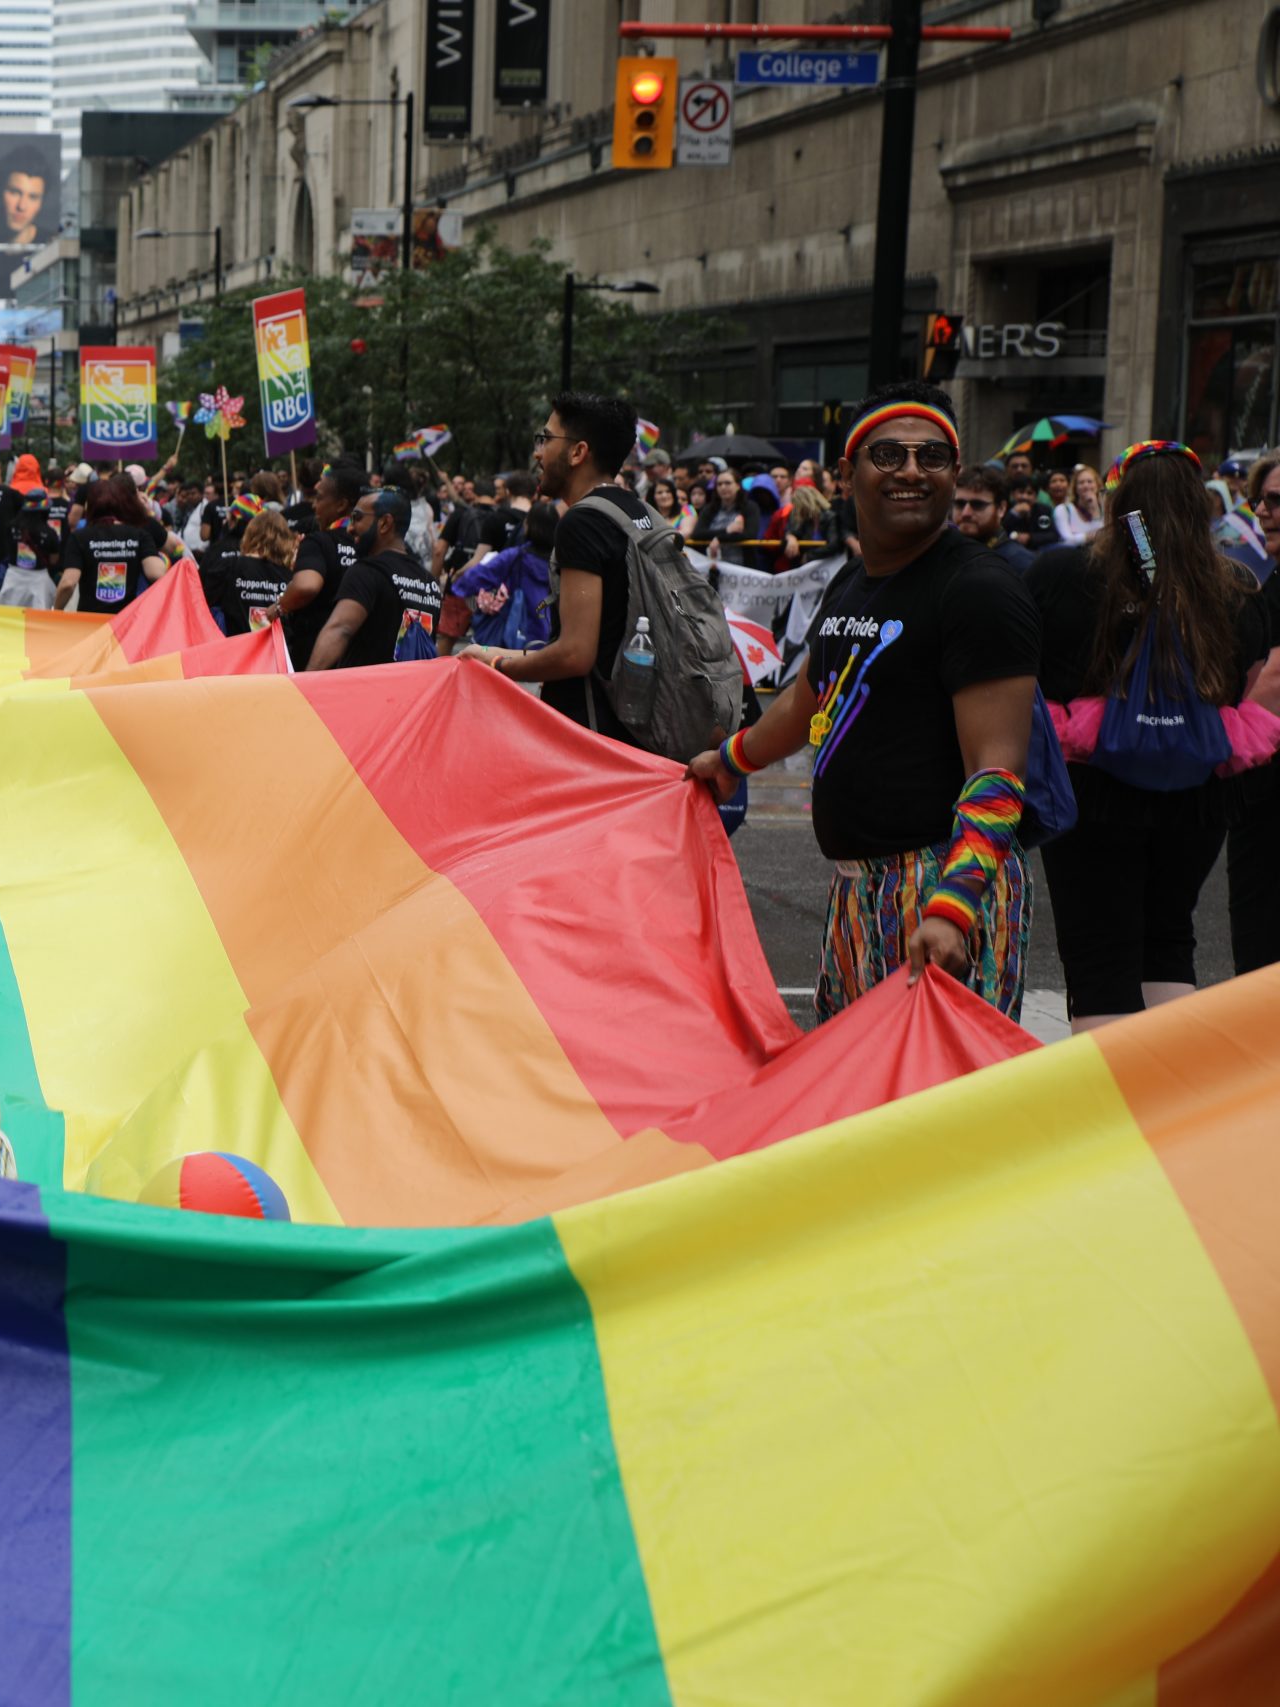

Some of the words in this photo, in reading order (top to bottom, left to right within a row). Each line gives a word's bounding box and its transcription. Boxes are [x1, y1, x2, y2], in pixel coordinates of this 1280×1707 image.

[757, 55, 842, 82] College
[271, 392, 307, 425] RBC
[95, 419, 145, 438] RBC
[236, 577, 279, 592] Supporting
[819, 616, 845, 637] RBC
[844, 615, 880, 638] Pride
